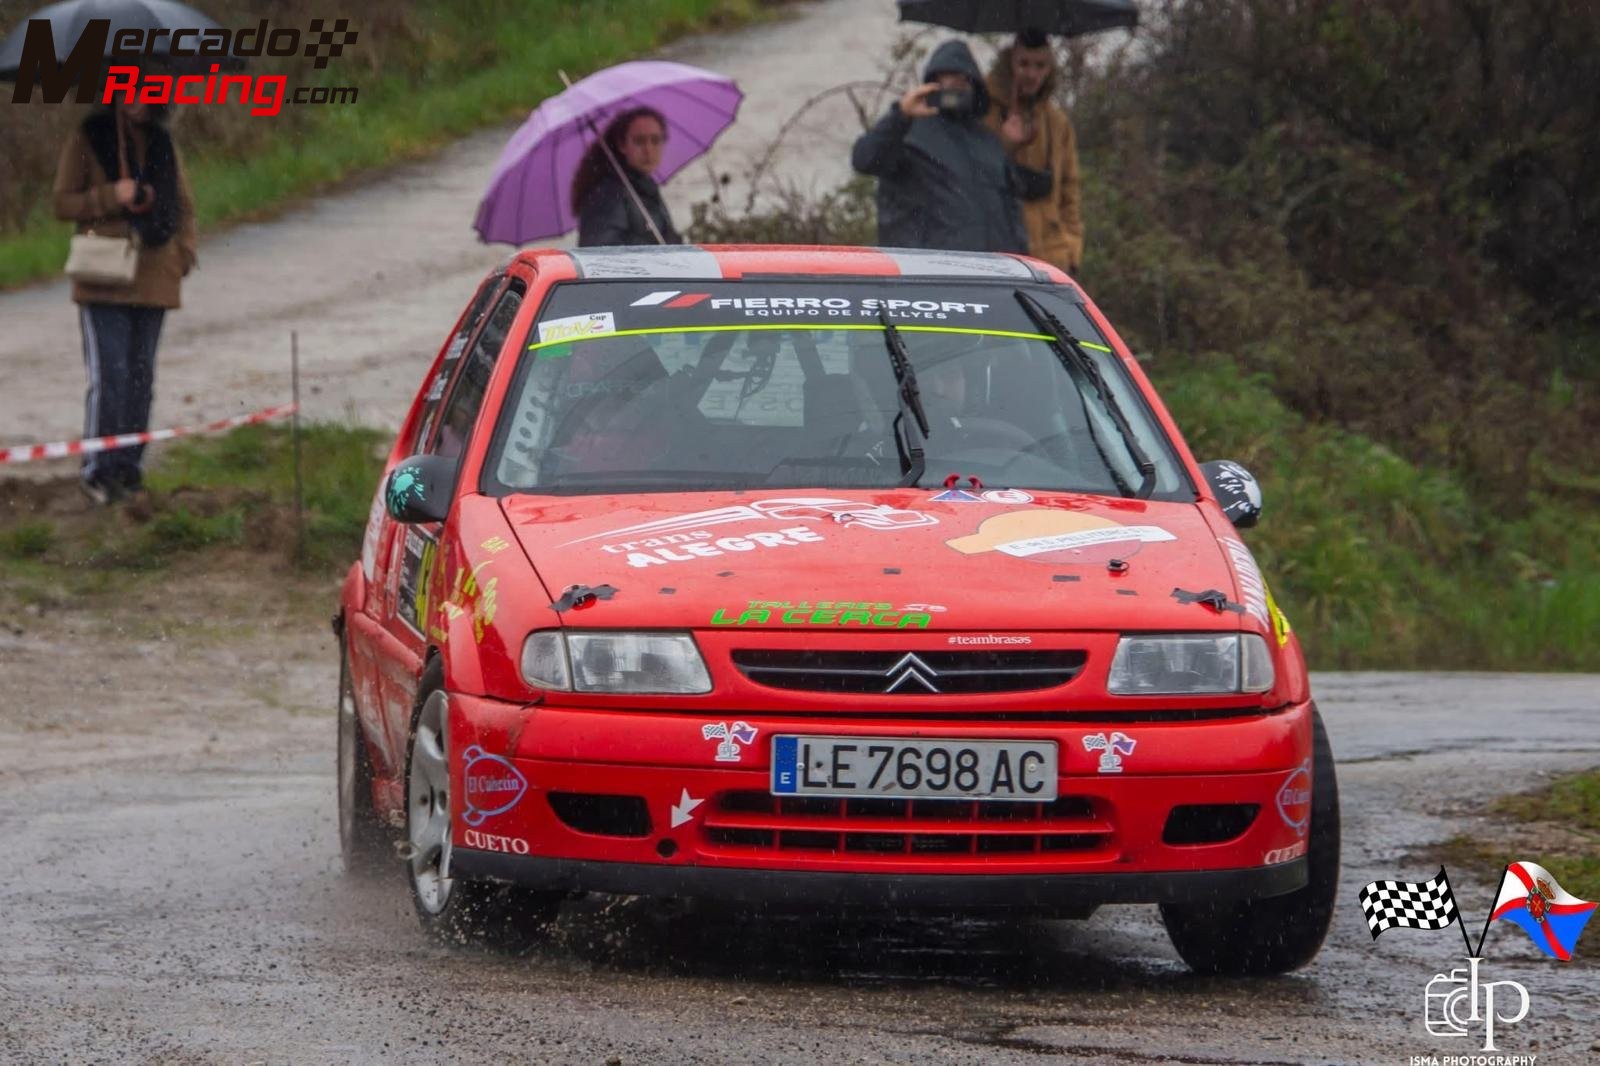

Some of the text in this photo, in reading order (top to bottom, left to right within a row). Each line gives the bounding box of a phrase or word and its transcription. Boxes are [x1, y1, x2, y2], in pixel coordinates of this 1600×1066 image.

[711, 297, 989, 314] FIERRO SPORT
[828, 309, 852, 317] DE
[601, 530, 713, 553] trans
[627, 526, 825, 568] ALEGRE
[748, 600, 892, 610] TALLERES
[711, 608, 932, 628] LA CERCA
[948, 634, 1032, 645] #teambrasas
[780, 772, 791, 784] E
[464, 829, 529, 855] CUETO
